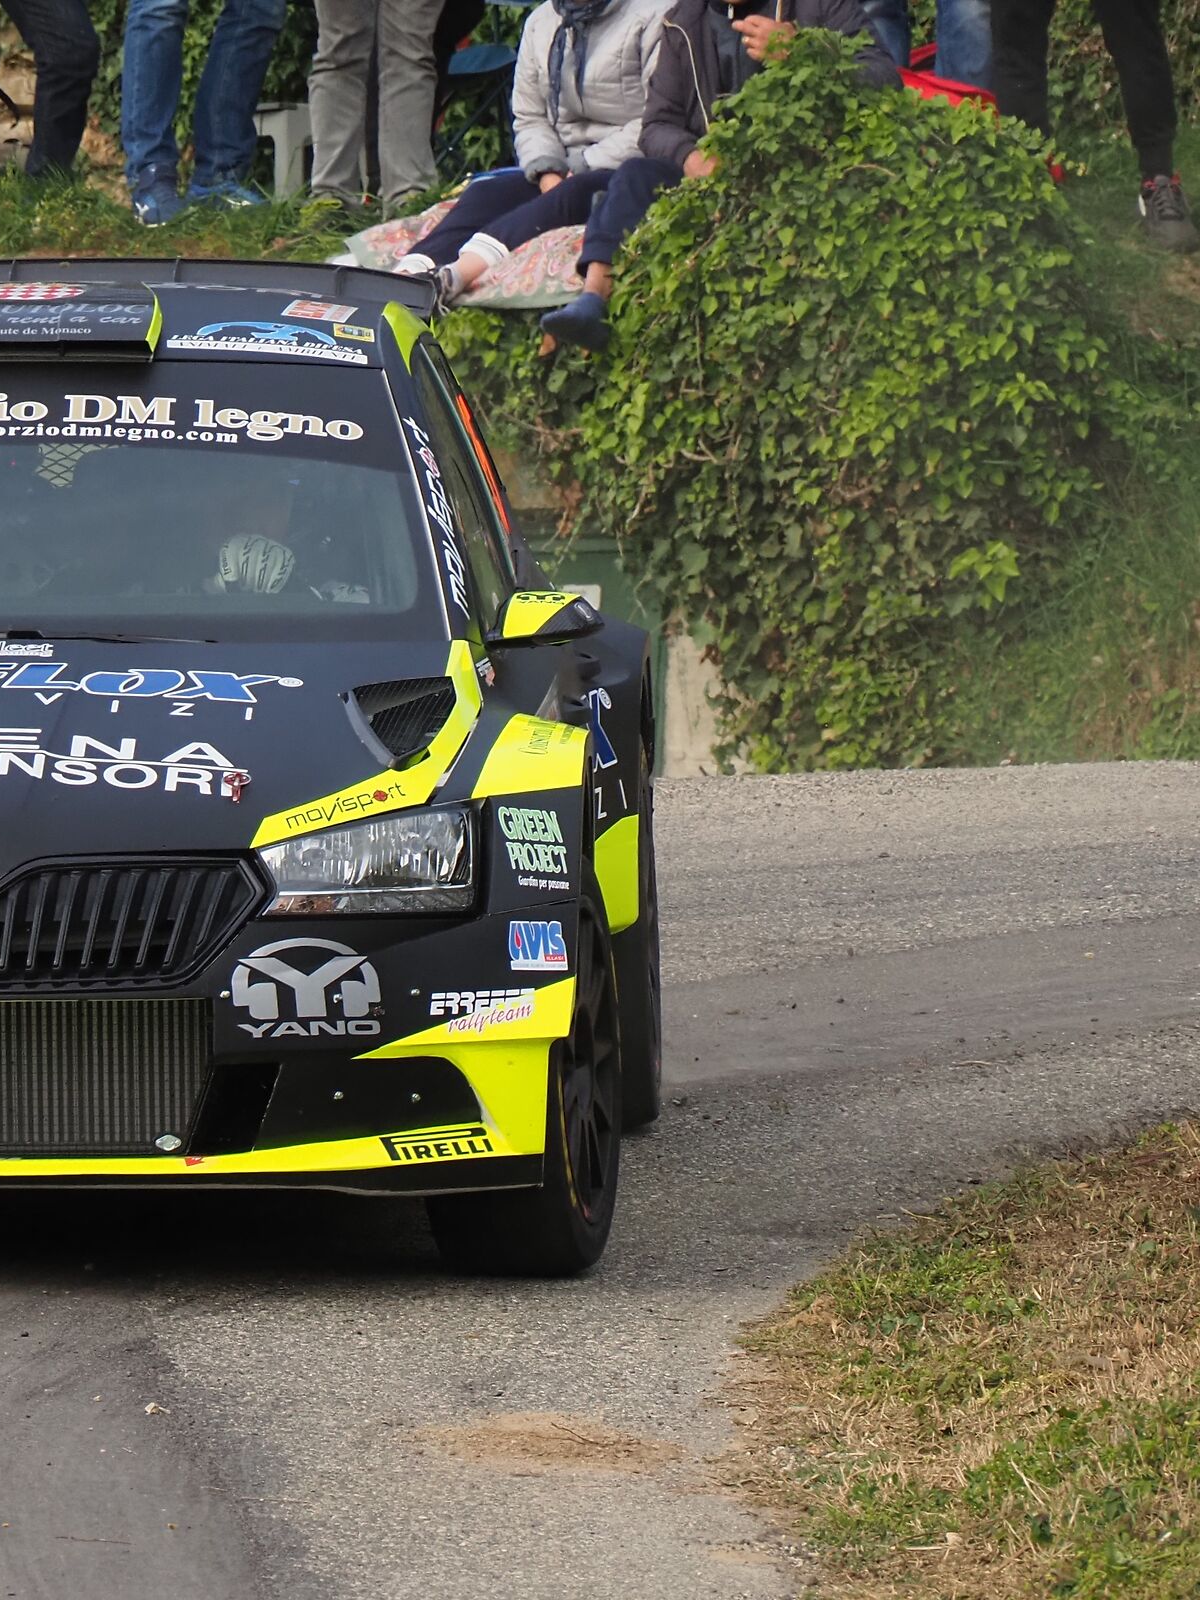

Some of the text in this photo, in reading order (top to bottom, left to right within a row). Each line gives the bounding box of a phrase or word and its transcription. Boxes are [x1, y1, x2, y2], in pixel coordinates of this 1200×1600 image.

[6, 314, 60, 326] rent
[70, 315, 89, 324] a
[99, 315, 144, 325] car
[22, 326, 39, 335] de
[40, 326, 92, 336] Monaco
[219, 335, 298, 346] ITALIANA
[62, 394, 177, 426] DM
[192, 398, 365, 442] legno
[284, 782, 407, 830] movisport
[498, 806, 563, 843] GREEN
[505, 842, 568, 874] PROJECT
[509, 921, 566, 961] AVIS
[237, 1020, 381, 1039] YANO
[379, 1127, 494, 1161] PIRELLI
